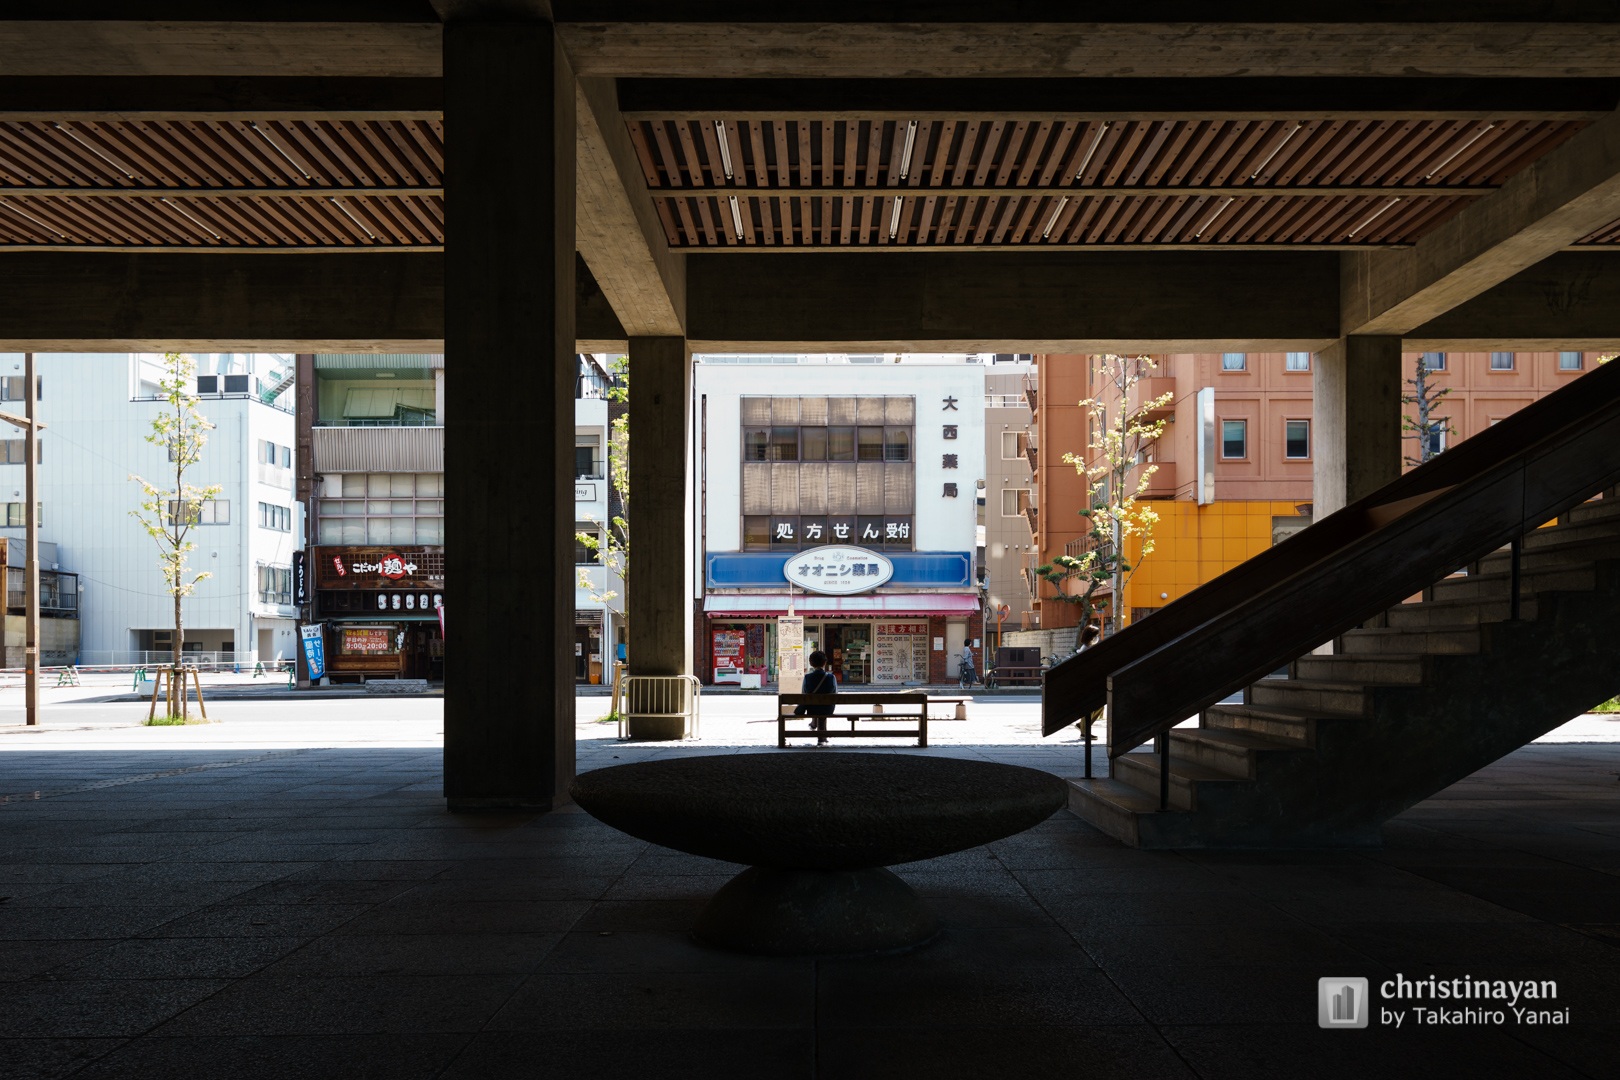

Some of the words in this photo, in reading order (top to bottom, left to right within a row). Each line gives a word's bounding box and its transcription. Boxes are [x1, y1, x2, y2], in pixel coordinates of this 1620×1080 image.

[942, 395, 959, 498] 大西薬局
[776, 522, 910, 539] 処方せん受付
[334, 557, 345, 576] セルフ
[352, 557, 418, 576] こだわり麺や
[798, 563, 880, 577] オオニシ薬局
[888, 624, 927, 633] 漢方相談
